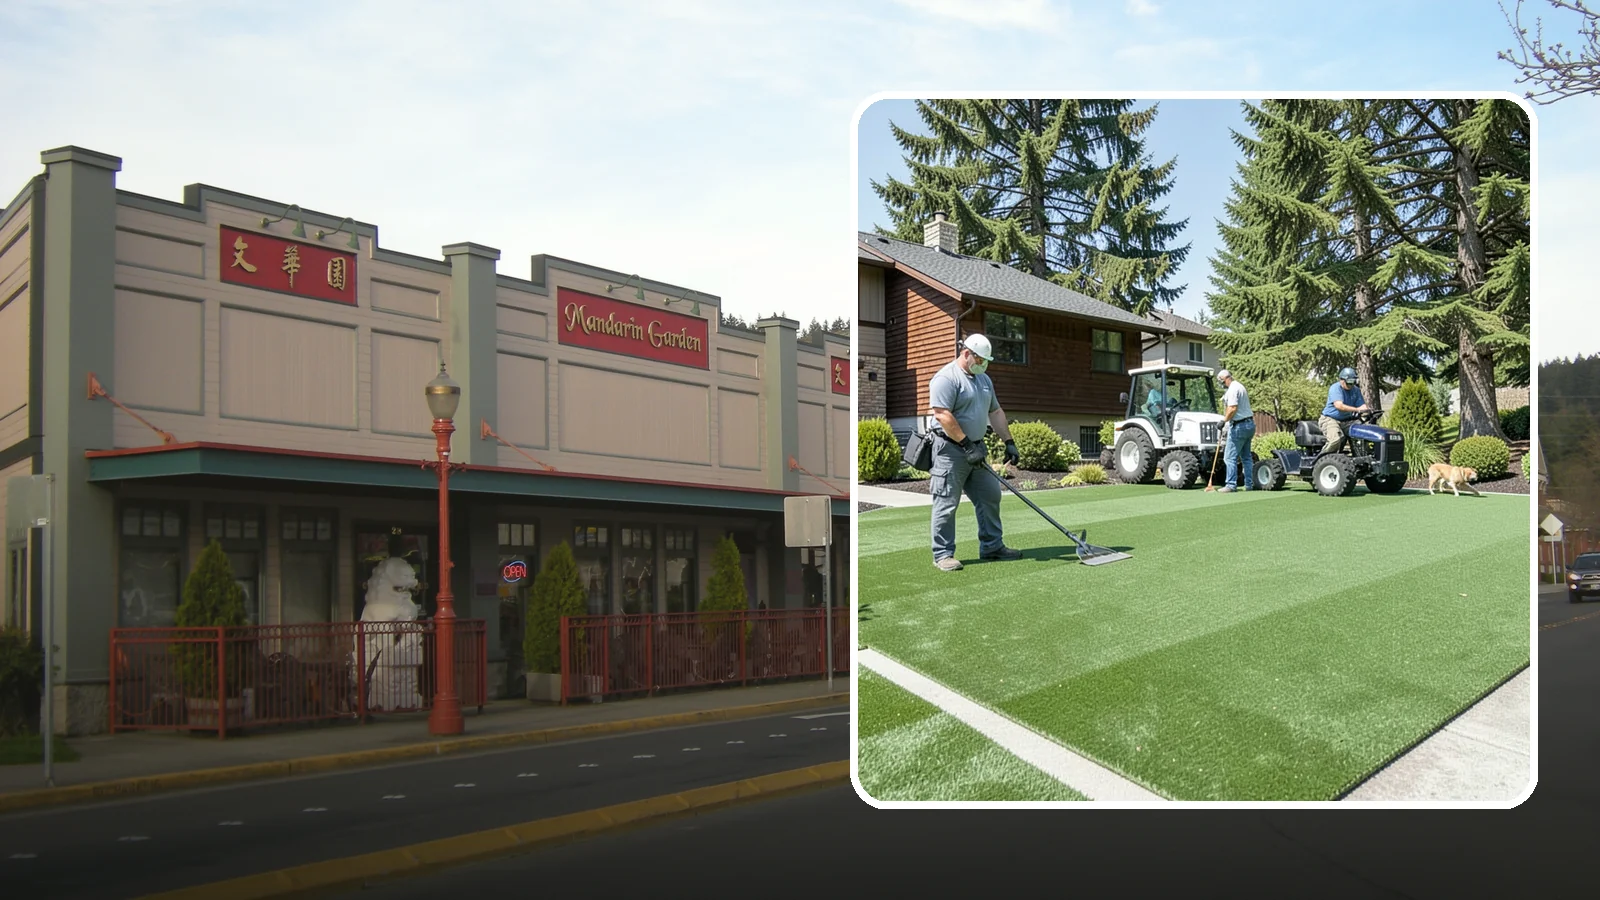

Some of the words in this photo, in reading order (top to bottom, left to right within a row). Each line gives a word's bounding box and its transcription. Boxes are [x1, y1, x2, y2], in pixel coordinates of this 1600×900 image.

[230, 235, 346, 291] 文華園
[564, 302, 644, 341] Mandarin
[647, 320, 702, 352] Garden
[503, 565, 527, 578] OPEN
